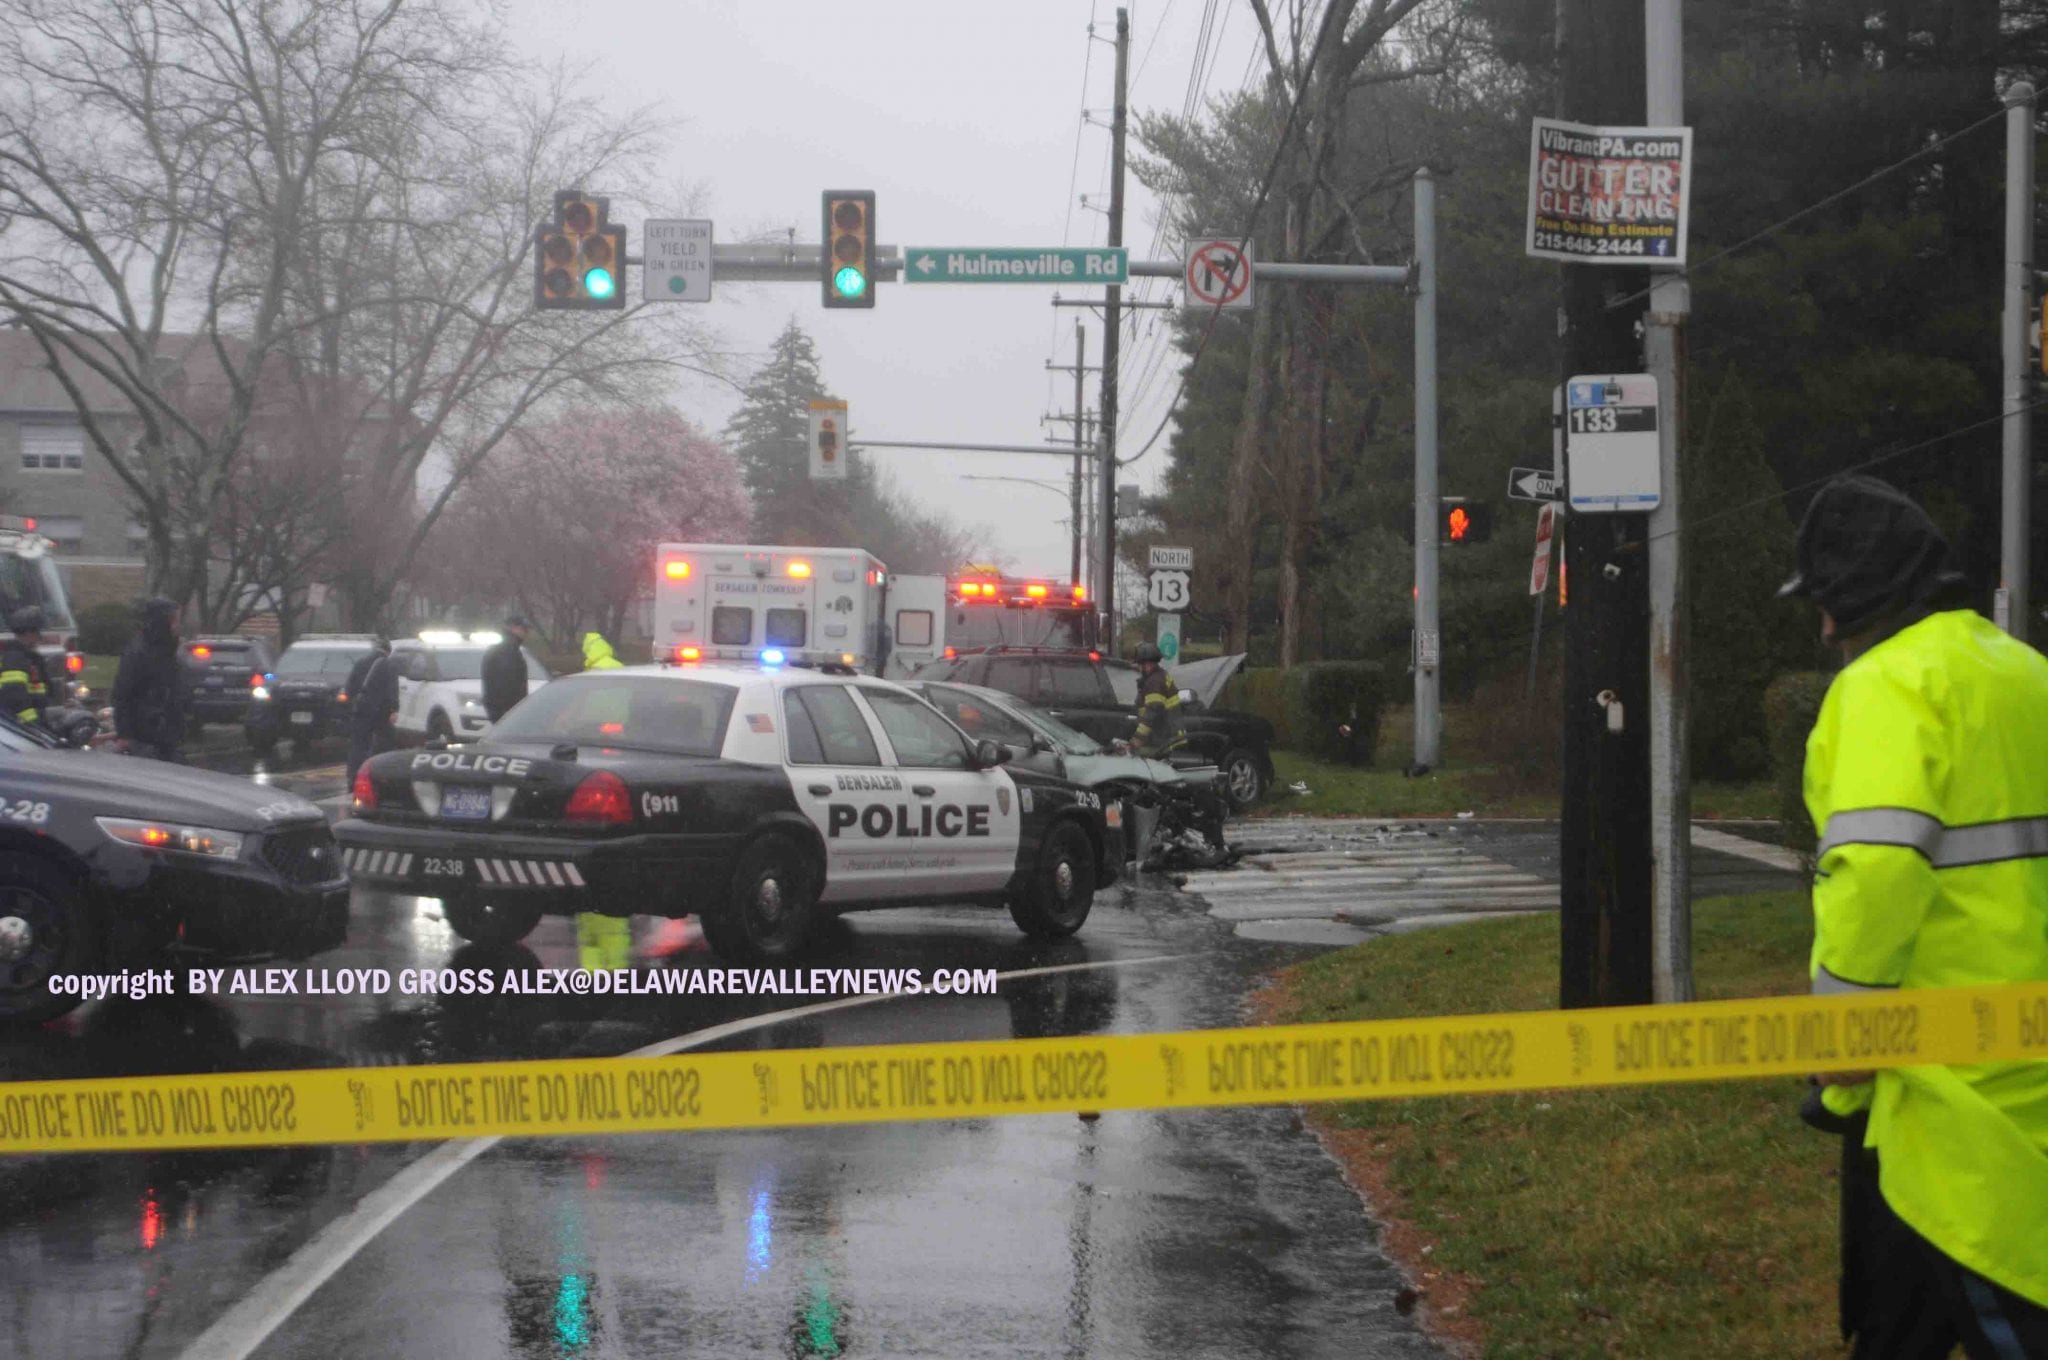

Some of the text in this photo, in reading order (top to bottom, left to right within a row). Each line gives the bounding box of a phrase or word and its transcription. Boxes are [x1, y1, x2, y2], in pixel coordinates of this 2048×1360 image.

[1541, 128, 1680, 157] VibrantPA.com
[1541, 157, 1673, 196] GUTTER
[1540, 191, 1675, 222] CLEANING
[649, 226, 675, 238] LEFT
[1607, 222, 1674, 238] Estimate
[661, 242, 697, 256] YIELD
[947, 254, 1119, 276] Hulmeville Rd
[1573, 408, 1617, 432] 133
[1536, 480, 1554, 493] ON
[1152, 550, 1189, 564] NORTH
[714, 581, 806, 593] BENSALEM TOWNSHIP
[1158, 579, 1182, 603] 13
[411, 753, 531, 776] POLICE
[836, 775, 902, 792] BENSALEM
[650, 795, 678, 813] 911
[828, 803, 990, 838] POLICE
[424, 858, 463, 875] 22-38
